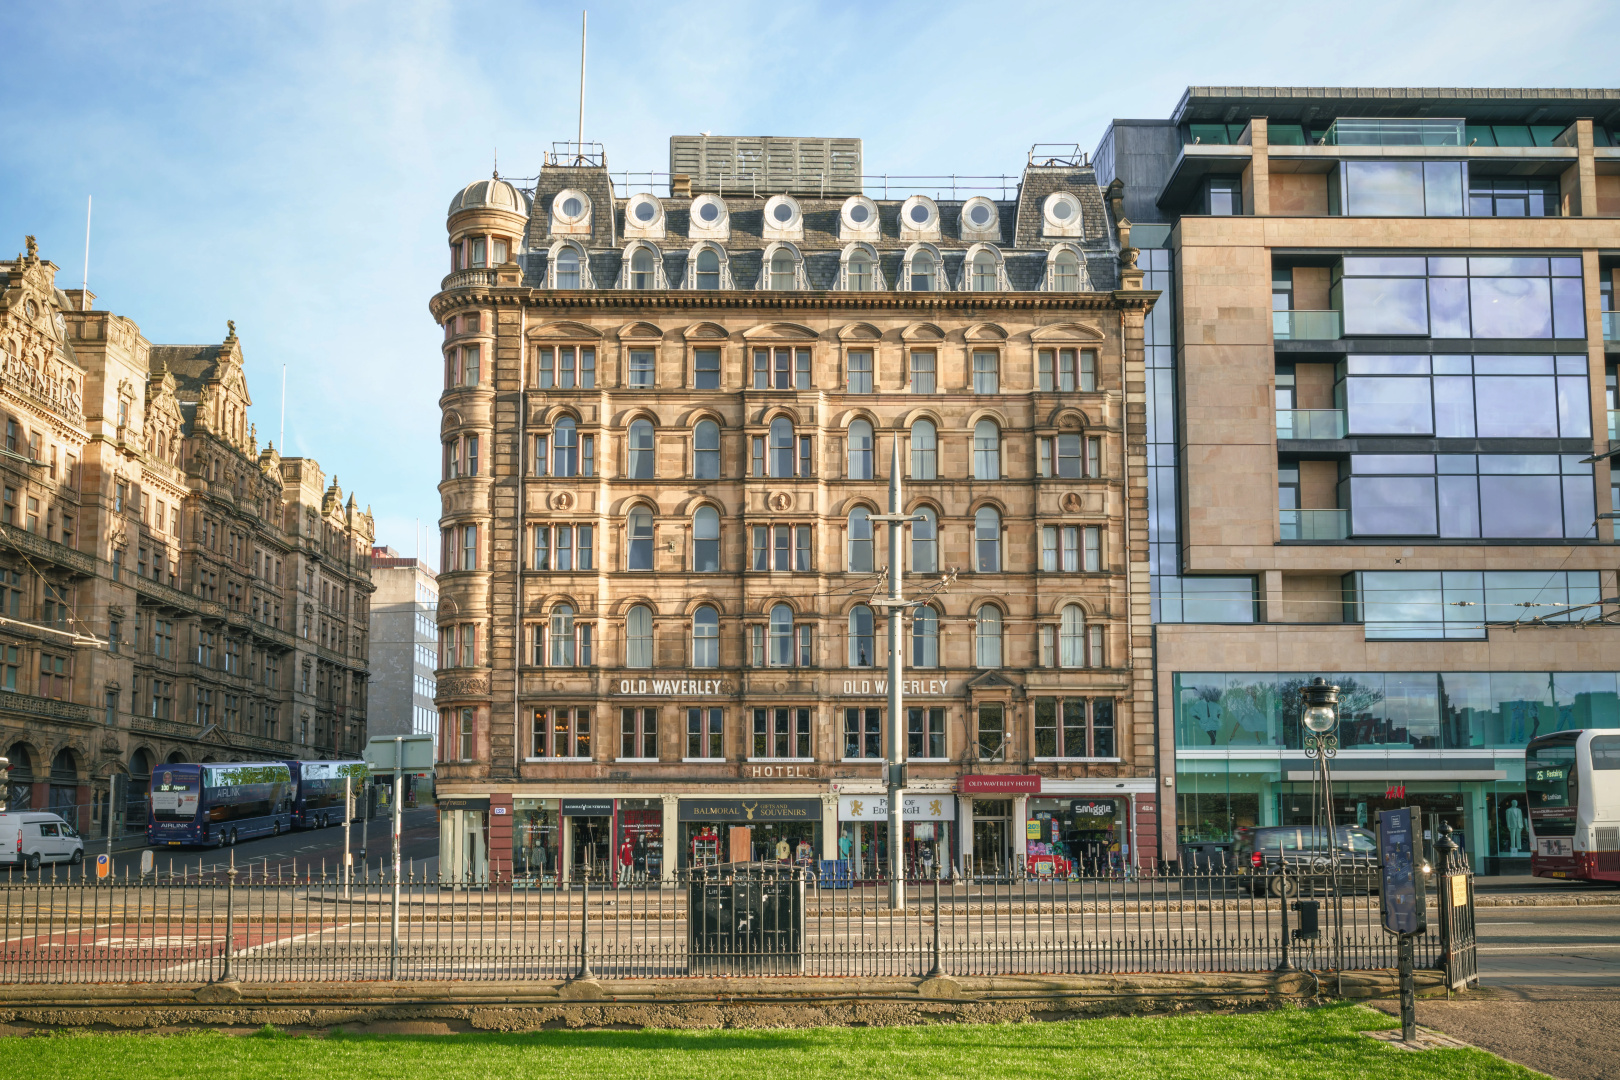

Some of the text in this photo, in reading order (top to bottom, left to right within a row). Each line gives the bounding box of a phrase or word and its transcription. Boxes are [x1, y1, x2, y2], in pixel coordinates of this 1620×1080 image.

[620, 679, 721, 694] OLD WAVERLEY
[843, 680, 948, 694] OLD WERLEY
[1536, 770, 1544, 780] 25
[216, 787, 241, 799] AIRLINK
[1385, 785, 1405, 799] H&M
[693, 807, 740, 815] BALMORAL
[760, 808, 807, 816] SOUVENIRS
[872, 806, 920, 815] EDIRGH
